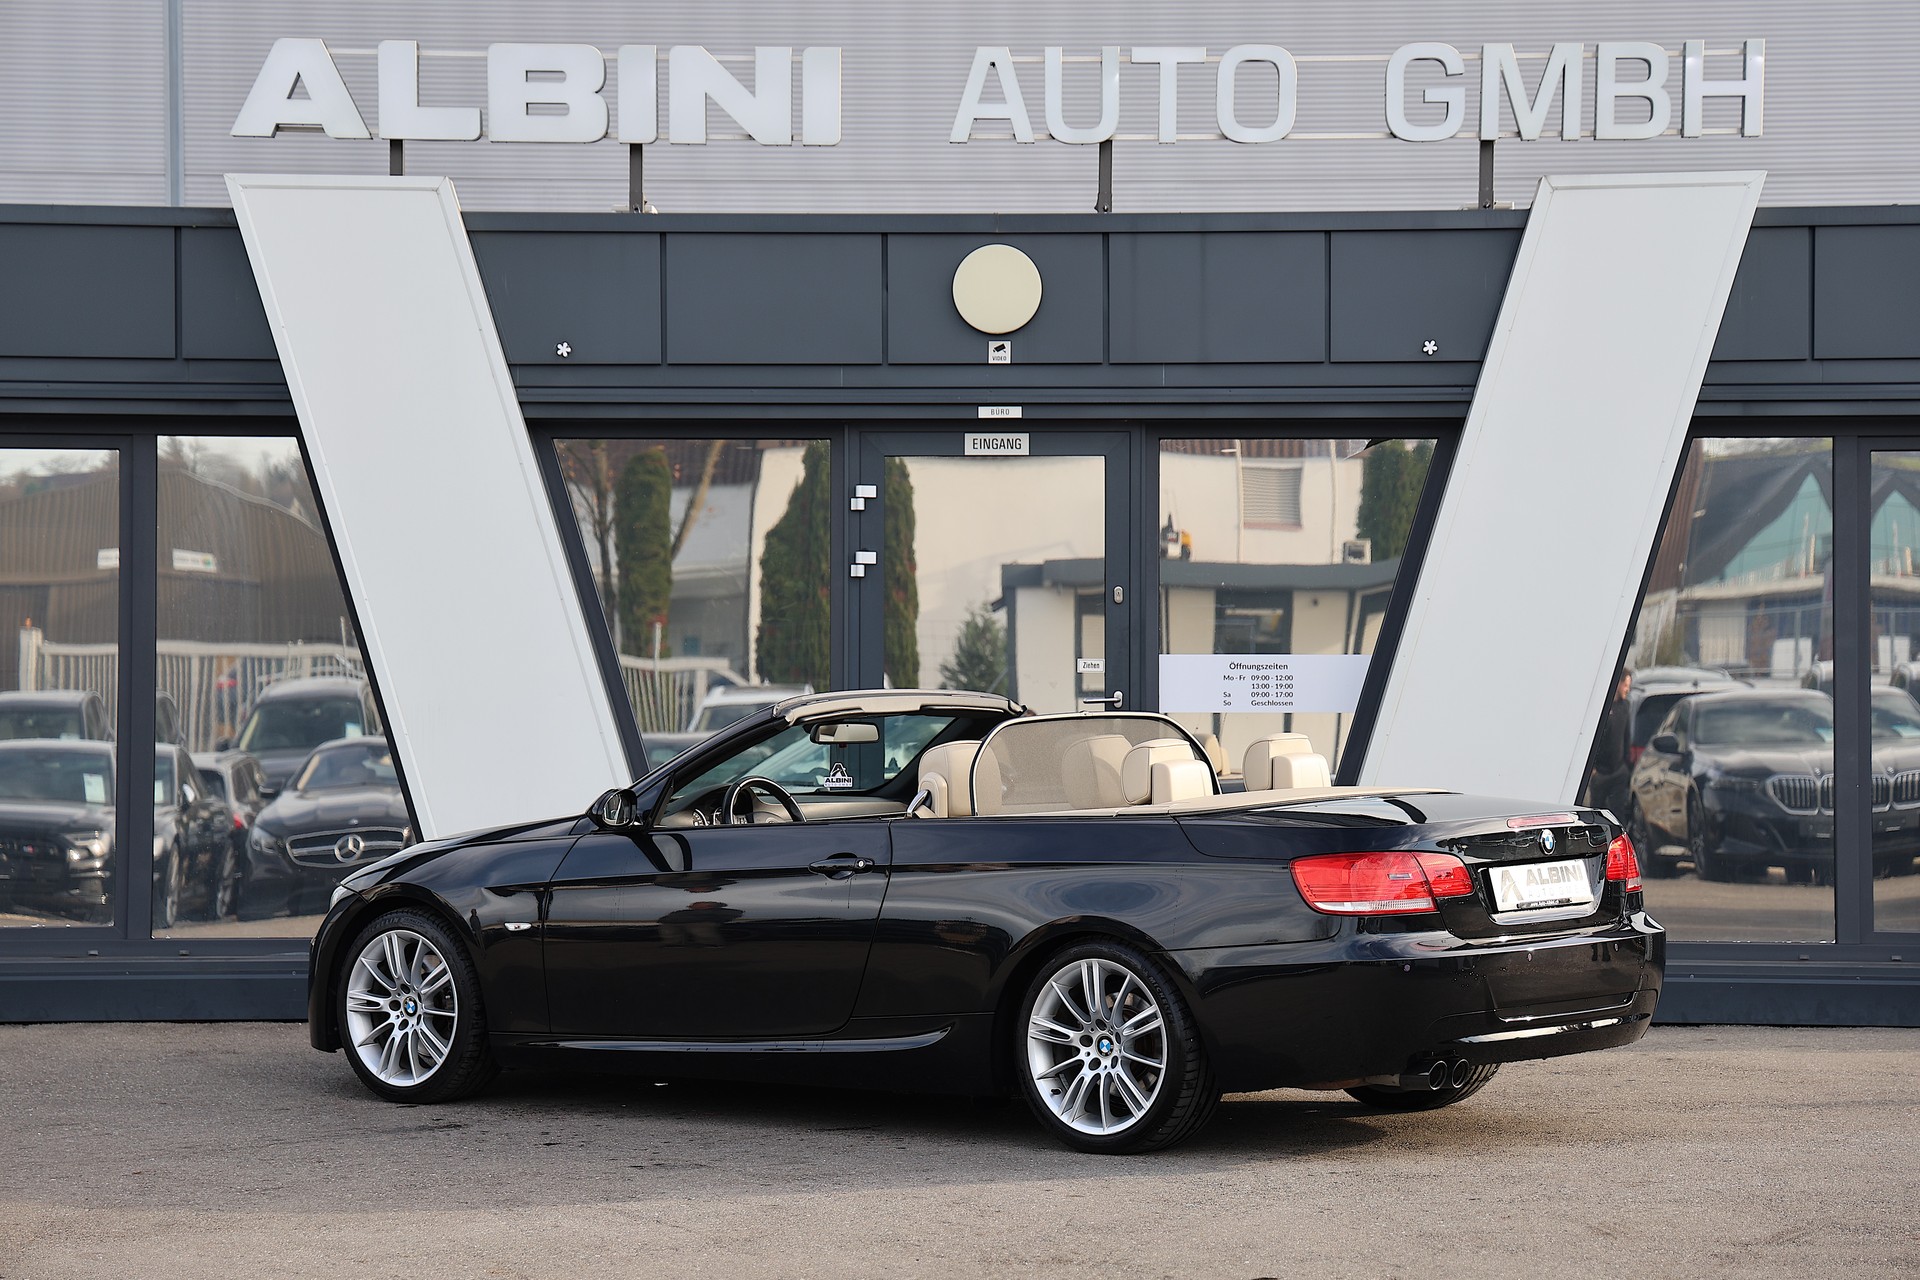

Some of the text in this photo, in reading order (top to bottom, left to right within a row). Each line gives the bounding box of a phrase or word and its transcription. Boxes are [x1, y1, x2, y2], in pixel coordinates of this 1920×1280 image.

[229, 37, 1766, 147] ALBINI AUTO GMBH
[972, 438, 1022, 450] EINGANG
[1229, 661, 1288, 671] Öffnungszeiten
[1527, 865, 1583, 886] ALBINI
